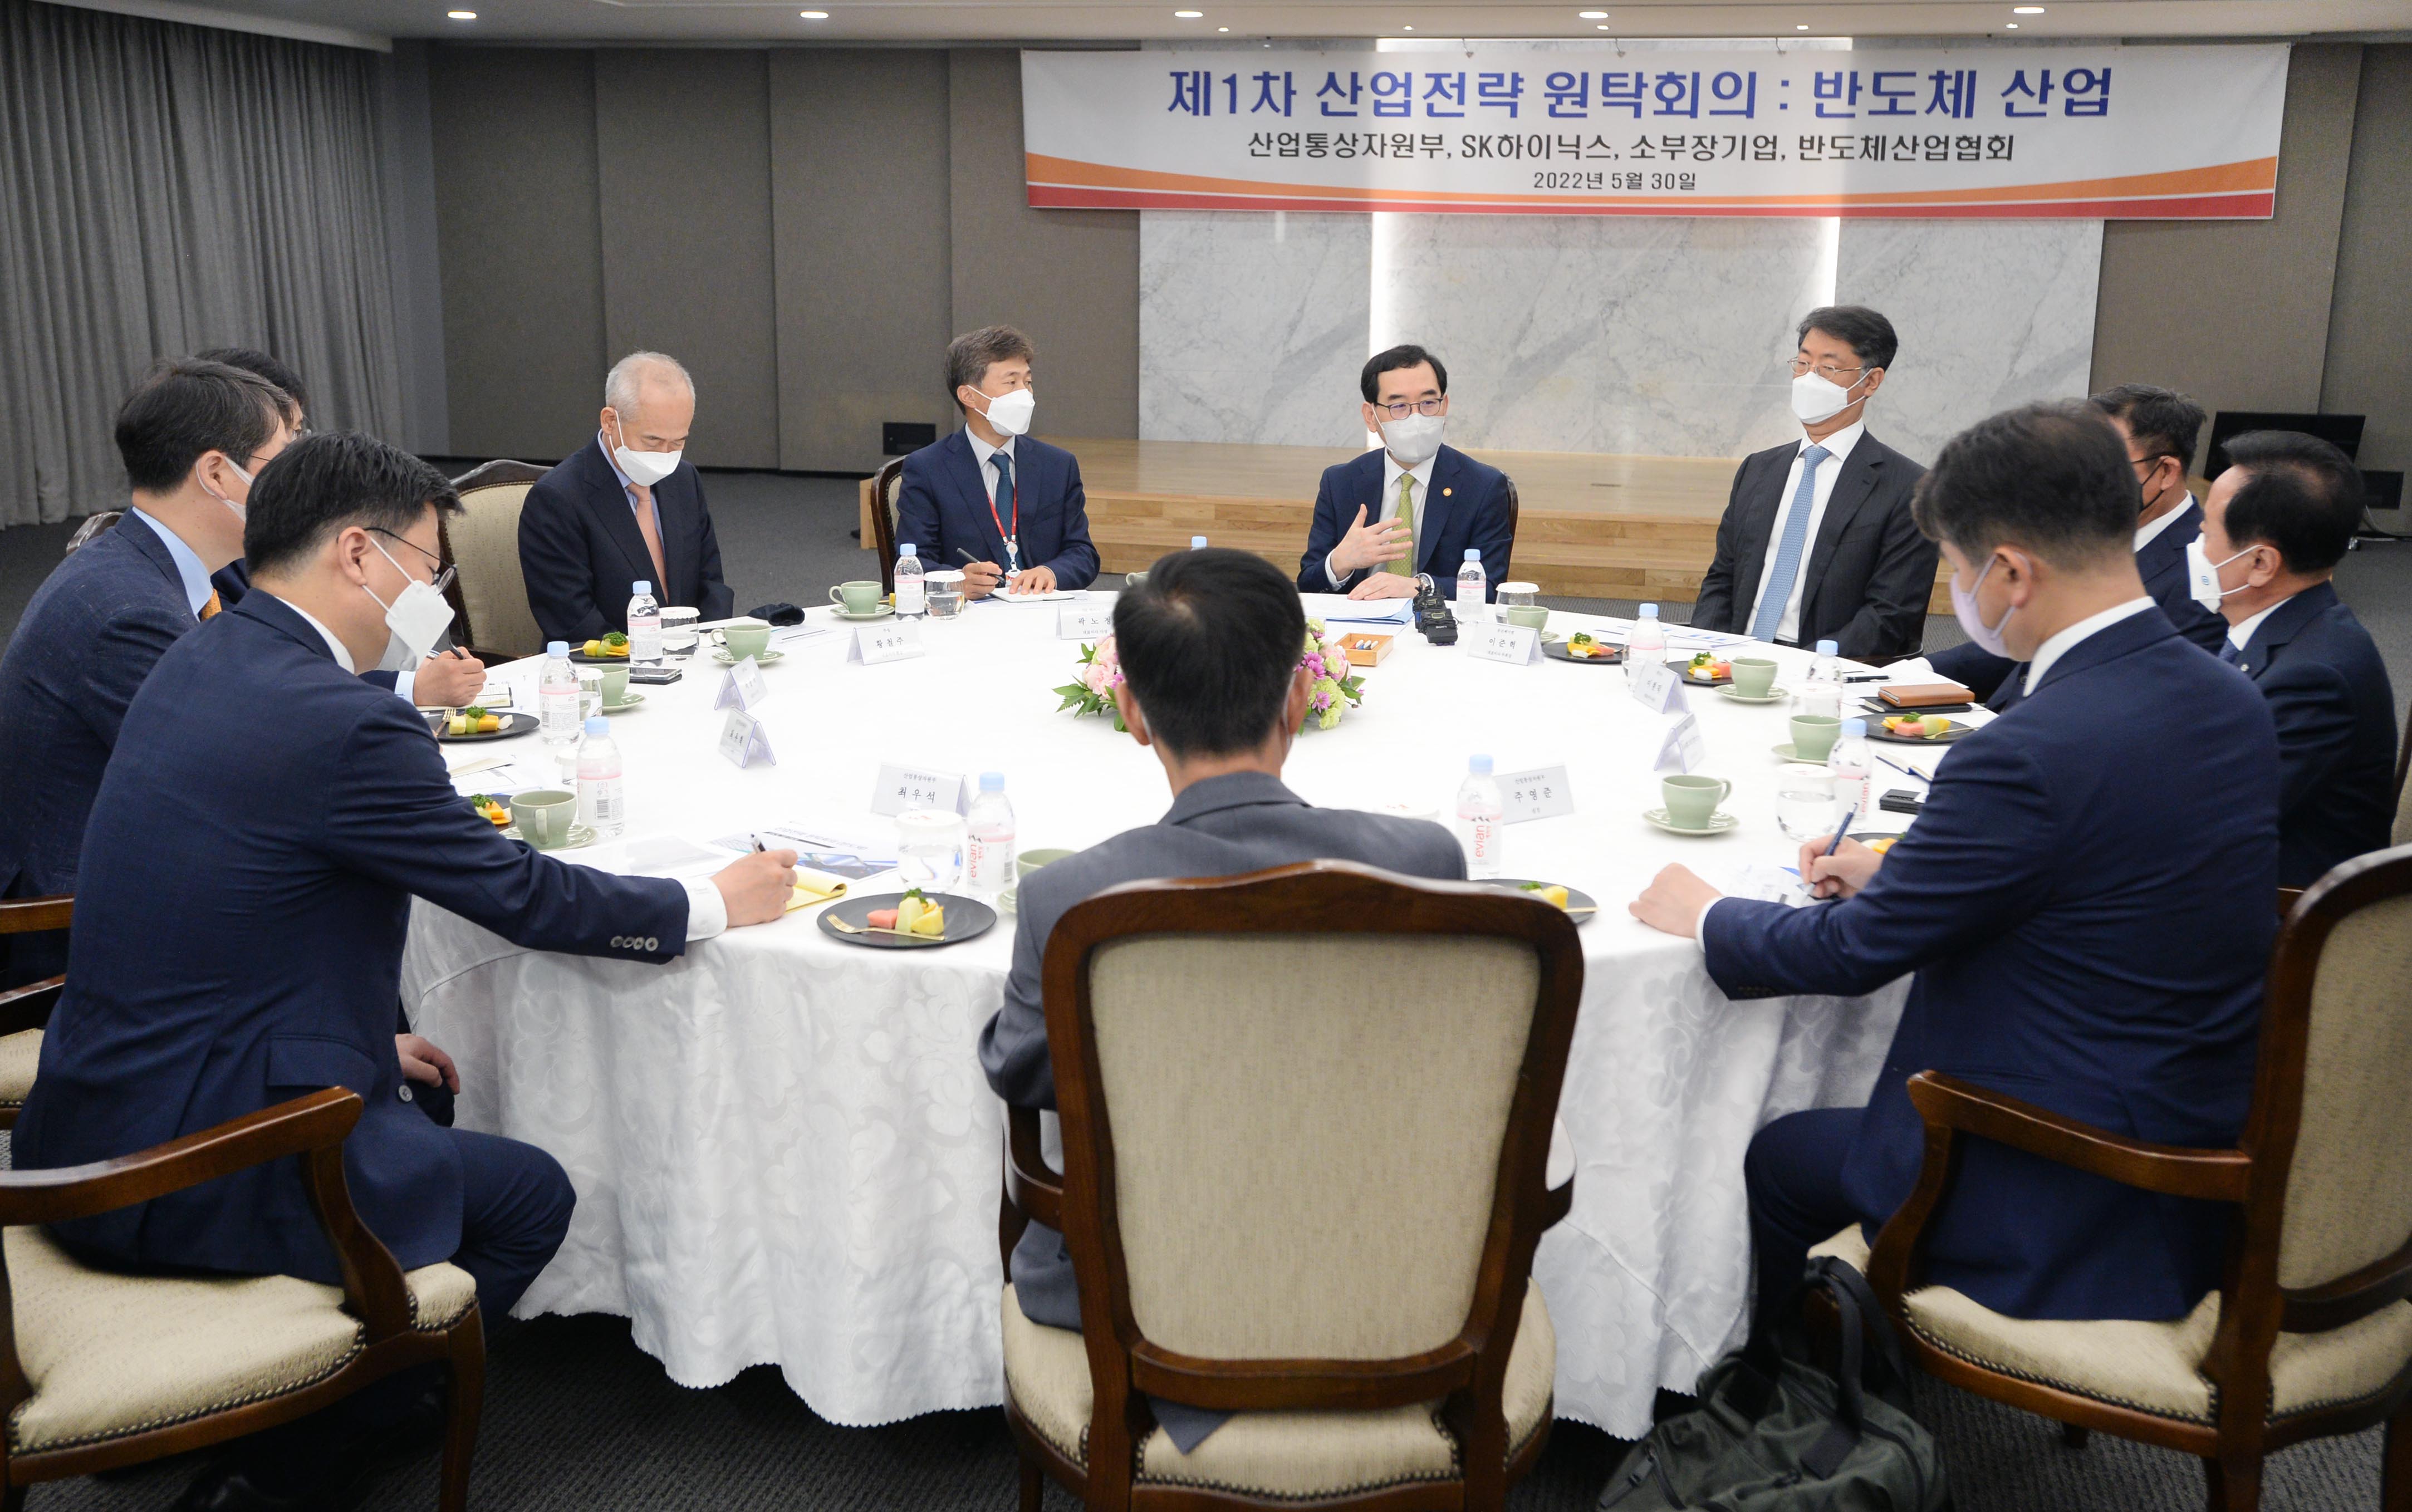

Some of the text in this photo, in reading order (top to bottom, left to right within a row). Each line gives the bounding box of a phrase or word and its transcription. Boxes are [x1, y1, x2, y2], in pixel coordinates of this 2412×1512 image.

[1169, 68, 2111, 119] 제1차 산업전략 원탁회의 : 반도체 산업
[1248, 132, 2014, 162] 산업통상자원부, SK하이닉스, 소부장기업, 반도체산업협회
[1533, 172, 1695, 190] 2022년 5월 30일
[898, 787, 936, 804] 최우석
[1514, 787, 1553, 803] 주영준
[1475, 825, 1484, 857] evian
